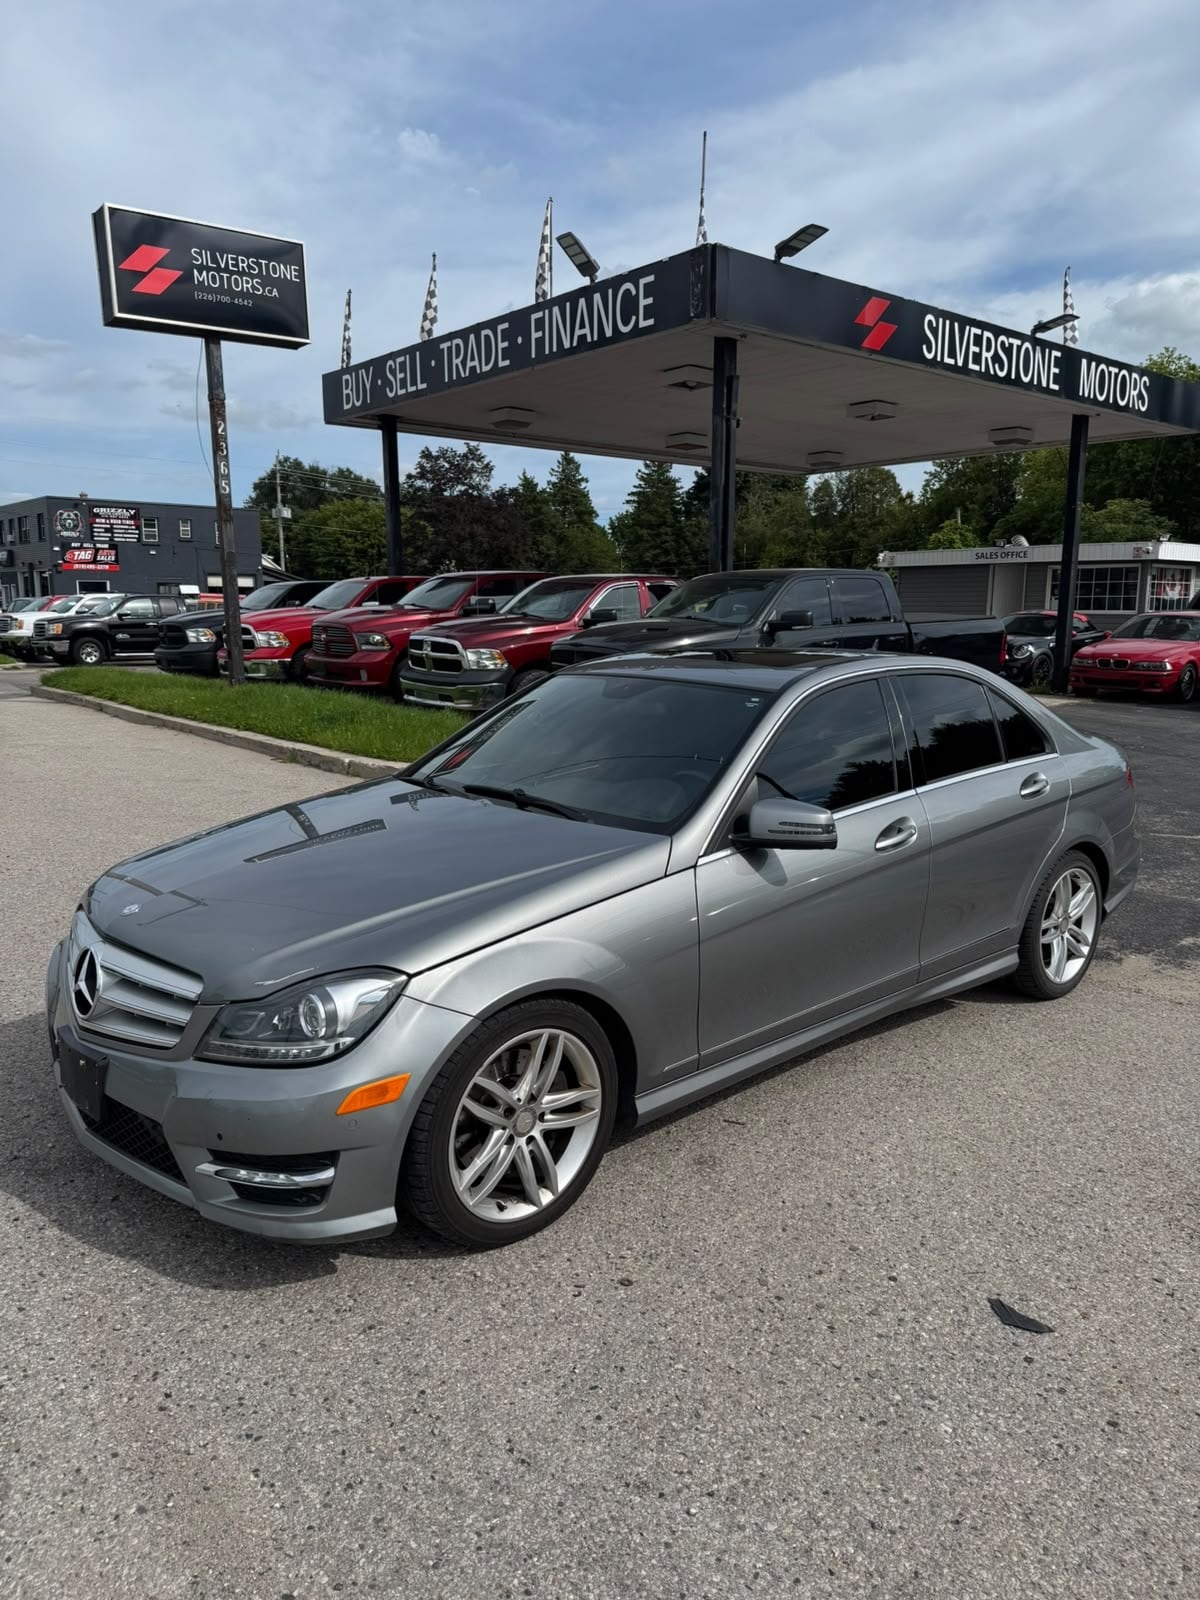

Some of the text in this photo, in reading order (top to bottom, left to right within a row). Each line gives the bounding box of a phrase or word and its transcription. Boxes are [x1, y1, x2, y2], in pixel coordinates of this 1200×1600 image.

[191, 248, 300, 282] SILVERSTONE
[194, 291, 253, 307] (226)700-4542
[342, 274, 655, 410] BUY SELL TRADE FINANCE
[922, 313, 1150, 413] SILVERSTONE MOTORS
[93, 507, 136, 515] GRIZZLY
[73, 550, 93, 561] TAG
[975, 550, 1028, 560] SALES OFFICE
